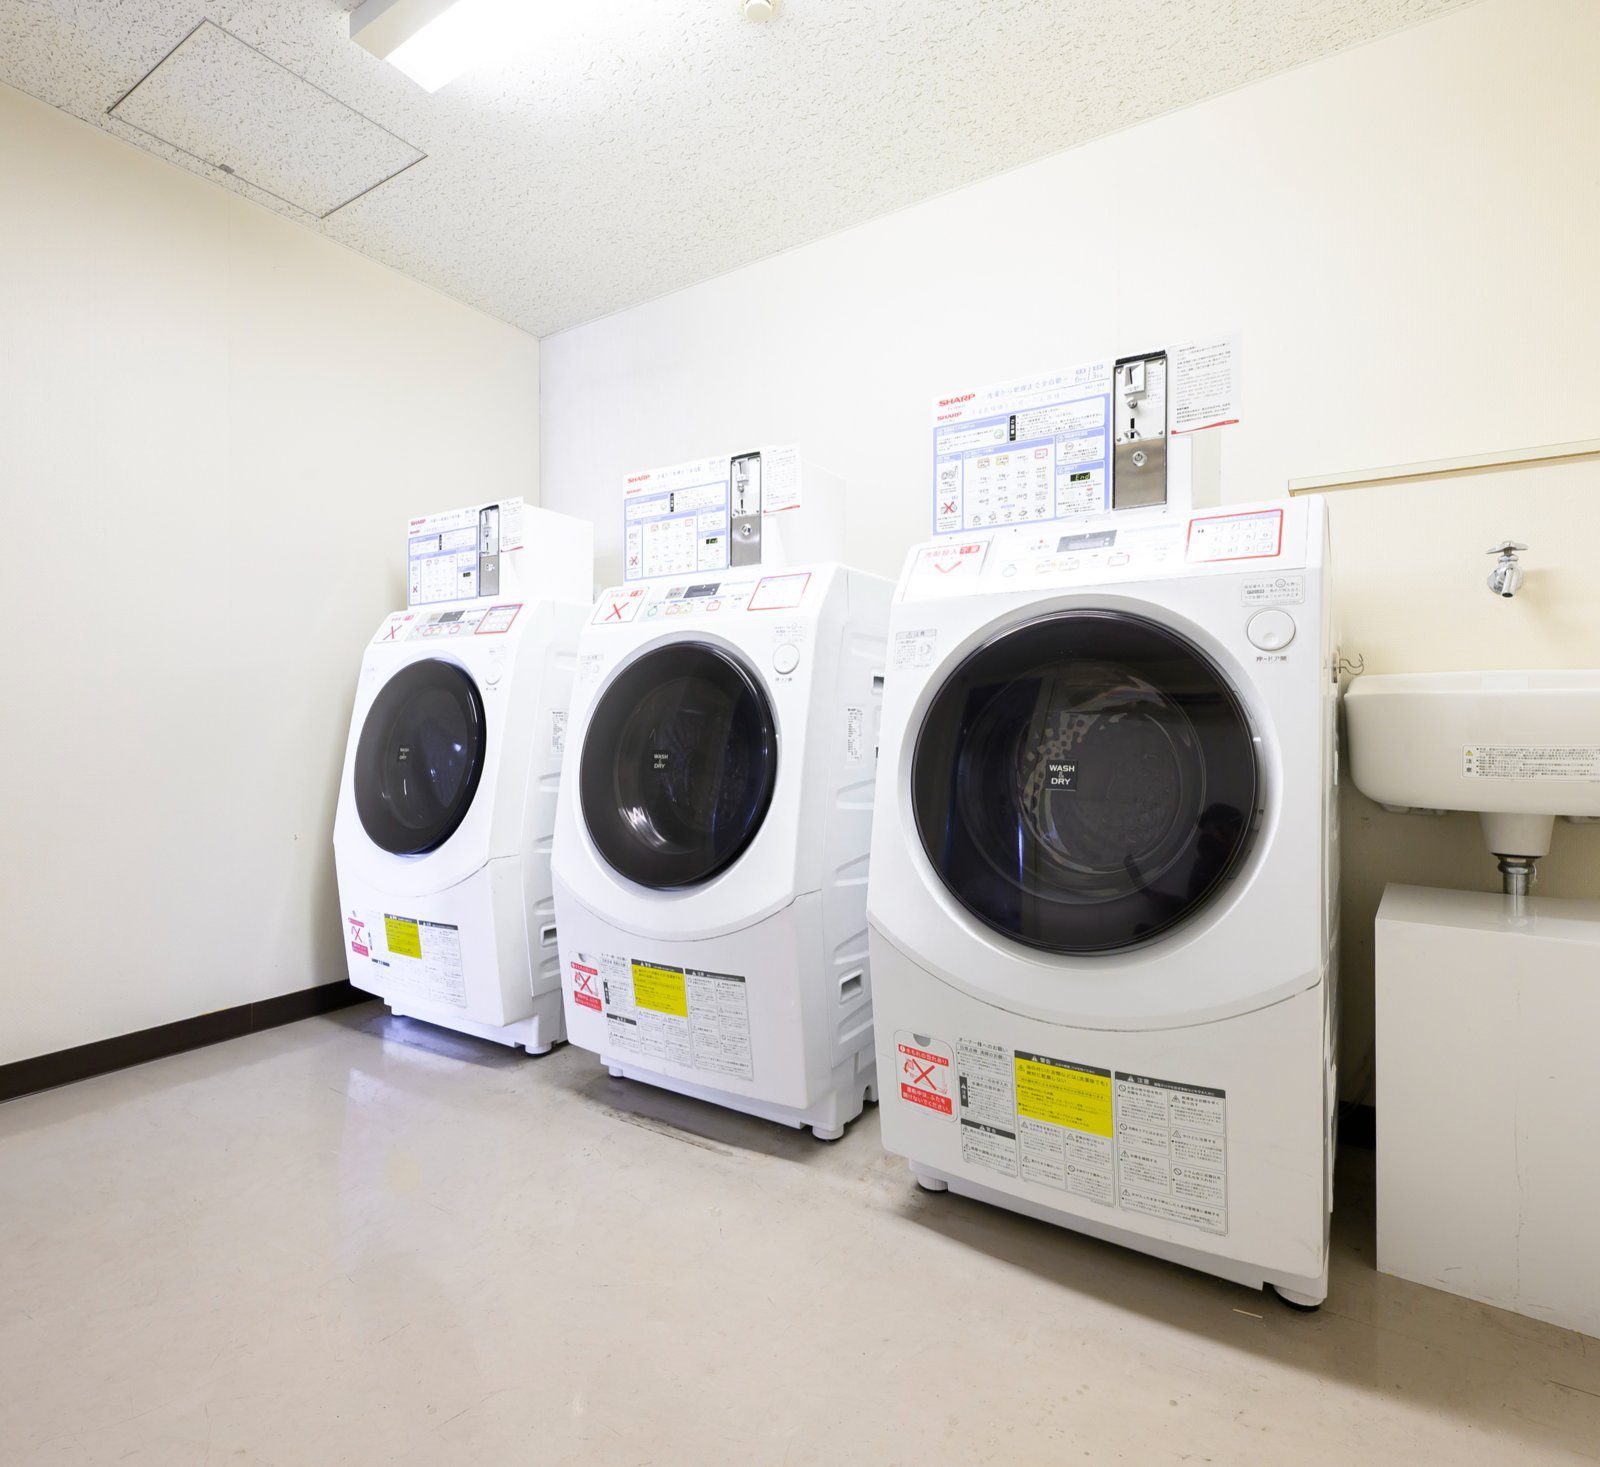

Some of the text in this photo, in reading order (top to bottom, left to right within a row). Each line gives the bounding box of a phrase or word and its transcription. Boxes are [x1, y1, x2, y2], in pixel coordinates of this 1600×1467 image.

[938, 393, 976, 407] SHARP
[937, 411, 962, 421] SHARP
[1049, 764, 1075, 772] WASH
[1051, 777, 1071, 785] DRY
